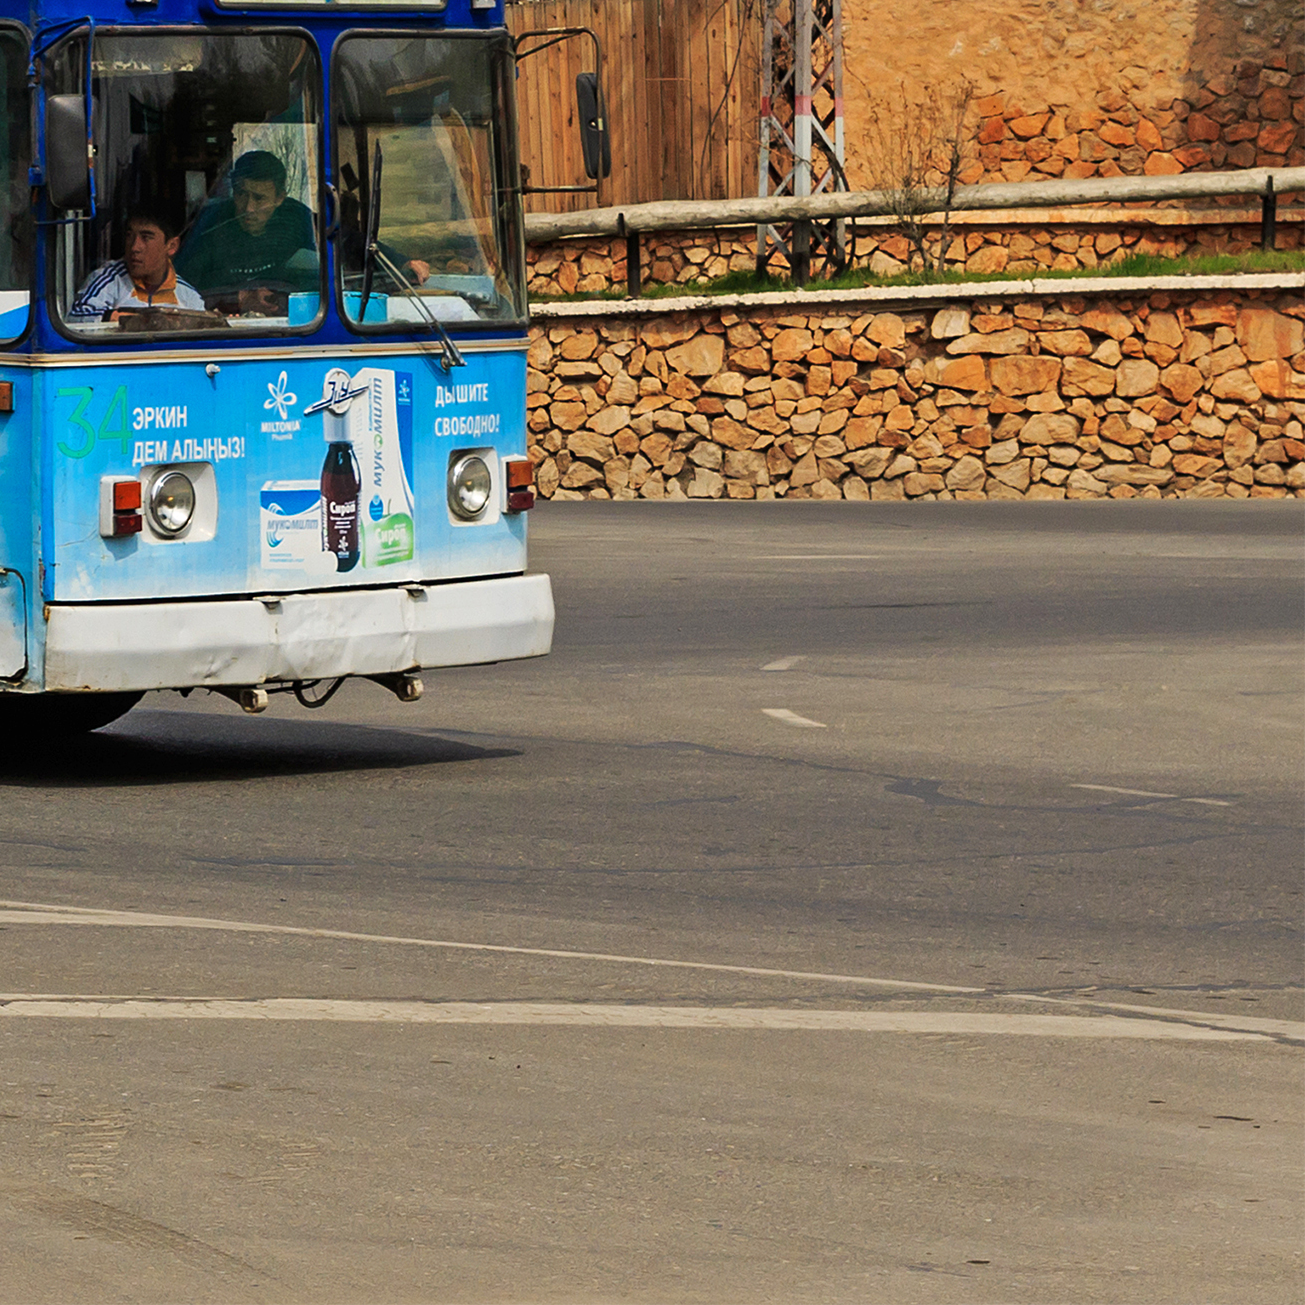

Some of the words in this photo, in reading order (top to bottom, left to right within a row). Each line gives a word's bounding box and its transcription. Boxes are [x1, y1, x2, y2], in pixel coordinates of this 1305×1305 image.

[435, 382, 489, 408] ДЫШИТЕ
[57, 385, 133, 459] 34
[132, 405, 188, 430] ЭРКИН
[261, 420, 301, 433] MILTONIA
[434, 414, 501, 438] СВОБОДНО!
[132, 440, 168, 466] ДЕМ
[171, 437, 245, 463] АЛЫҢЫЗ!
